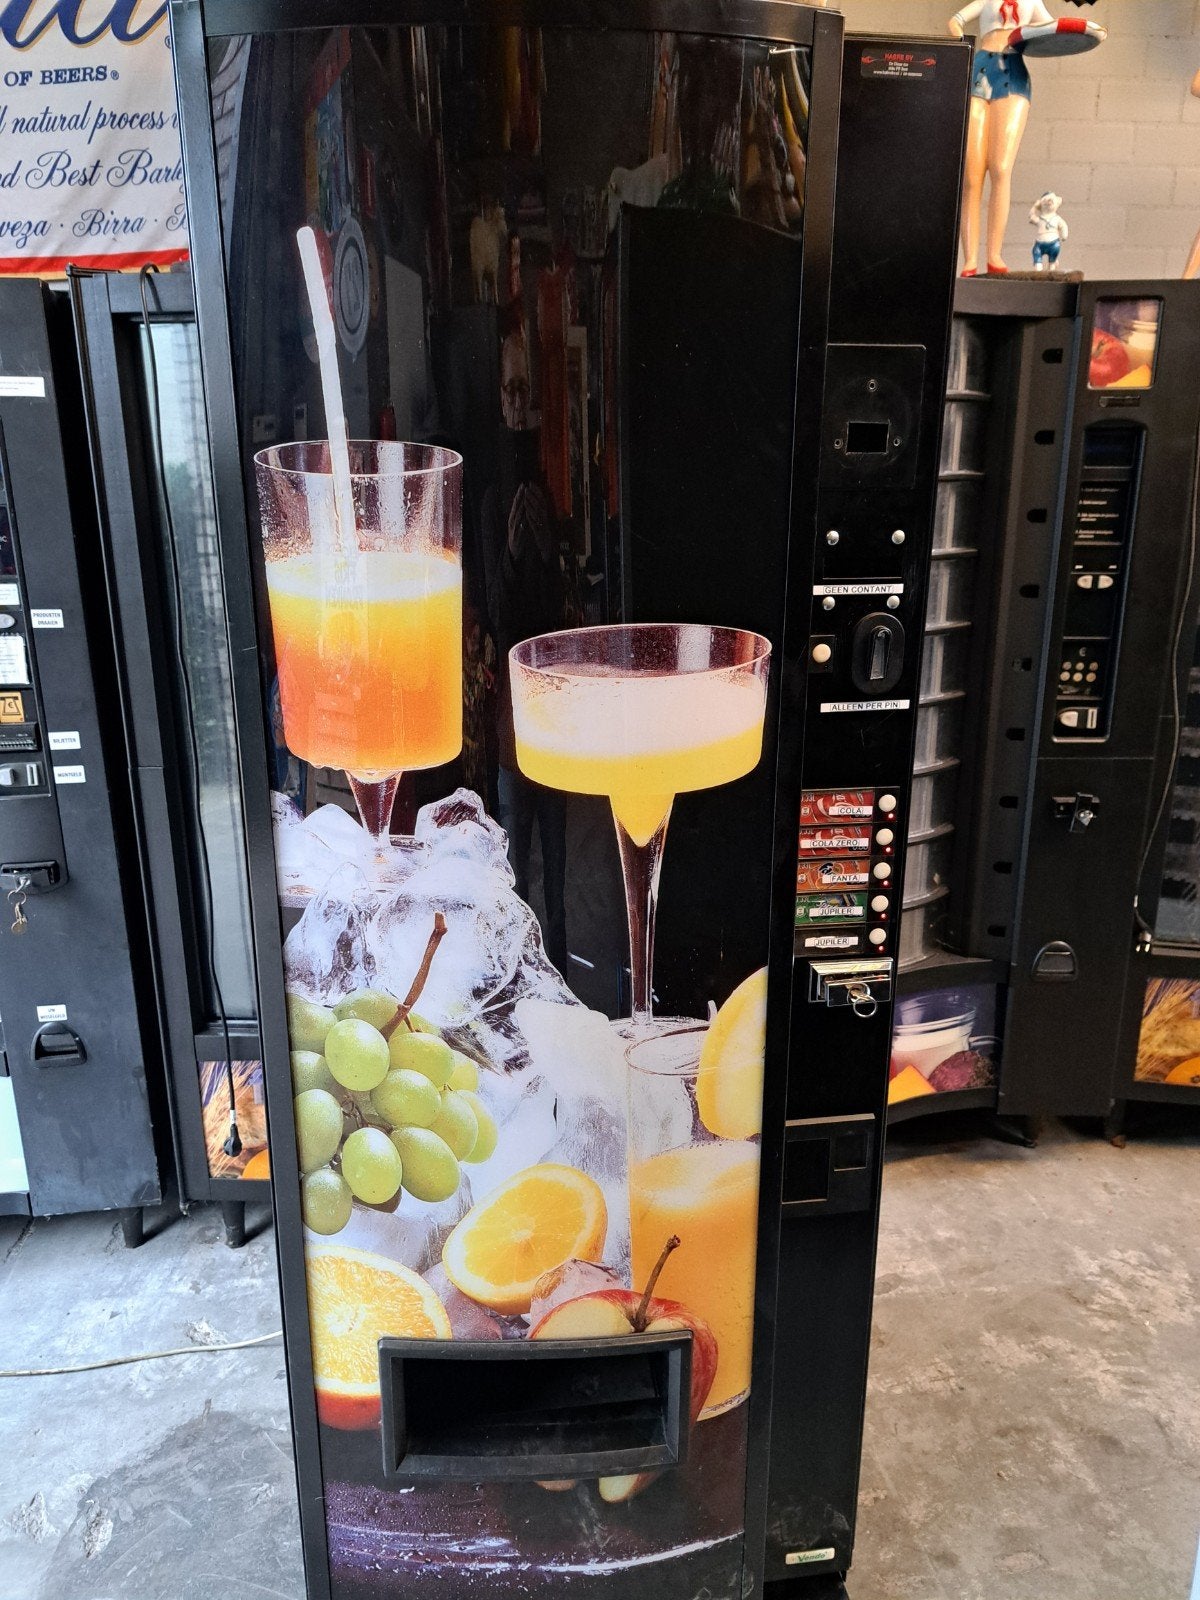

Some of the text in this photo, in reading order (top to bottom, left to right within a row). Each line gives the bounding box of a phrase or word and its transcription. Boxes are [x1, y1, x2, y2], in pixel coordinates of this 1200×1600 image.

[4, 71, 32, 86] OF
[12, 101, 91, 134] natural
[88, 106, 168, 144] process
[26, 149, 101, 189] Best
[72, 208, 146, 239] Birra
[824, 585, 893, 594] GEEN CONTANT
[831, 702, 899, 711] ALLEEN PER PIN
[839, 807, 863, 815] COLA
[812, 839, 859, 848] COLA ZERO
[831, 874, 859, 882] FANTA
[820, 908, 854, 916] JUPILER
[815, 938, 849, 946] JUPILER
[797, 1553, 826, 1561] Vendo
